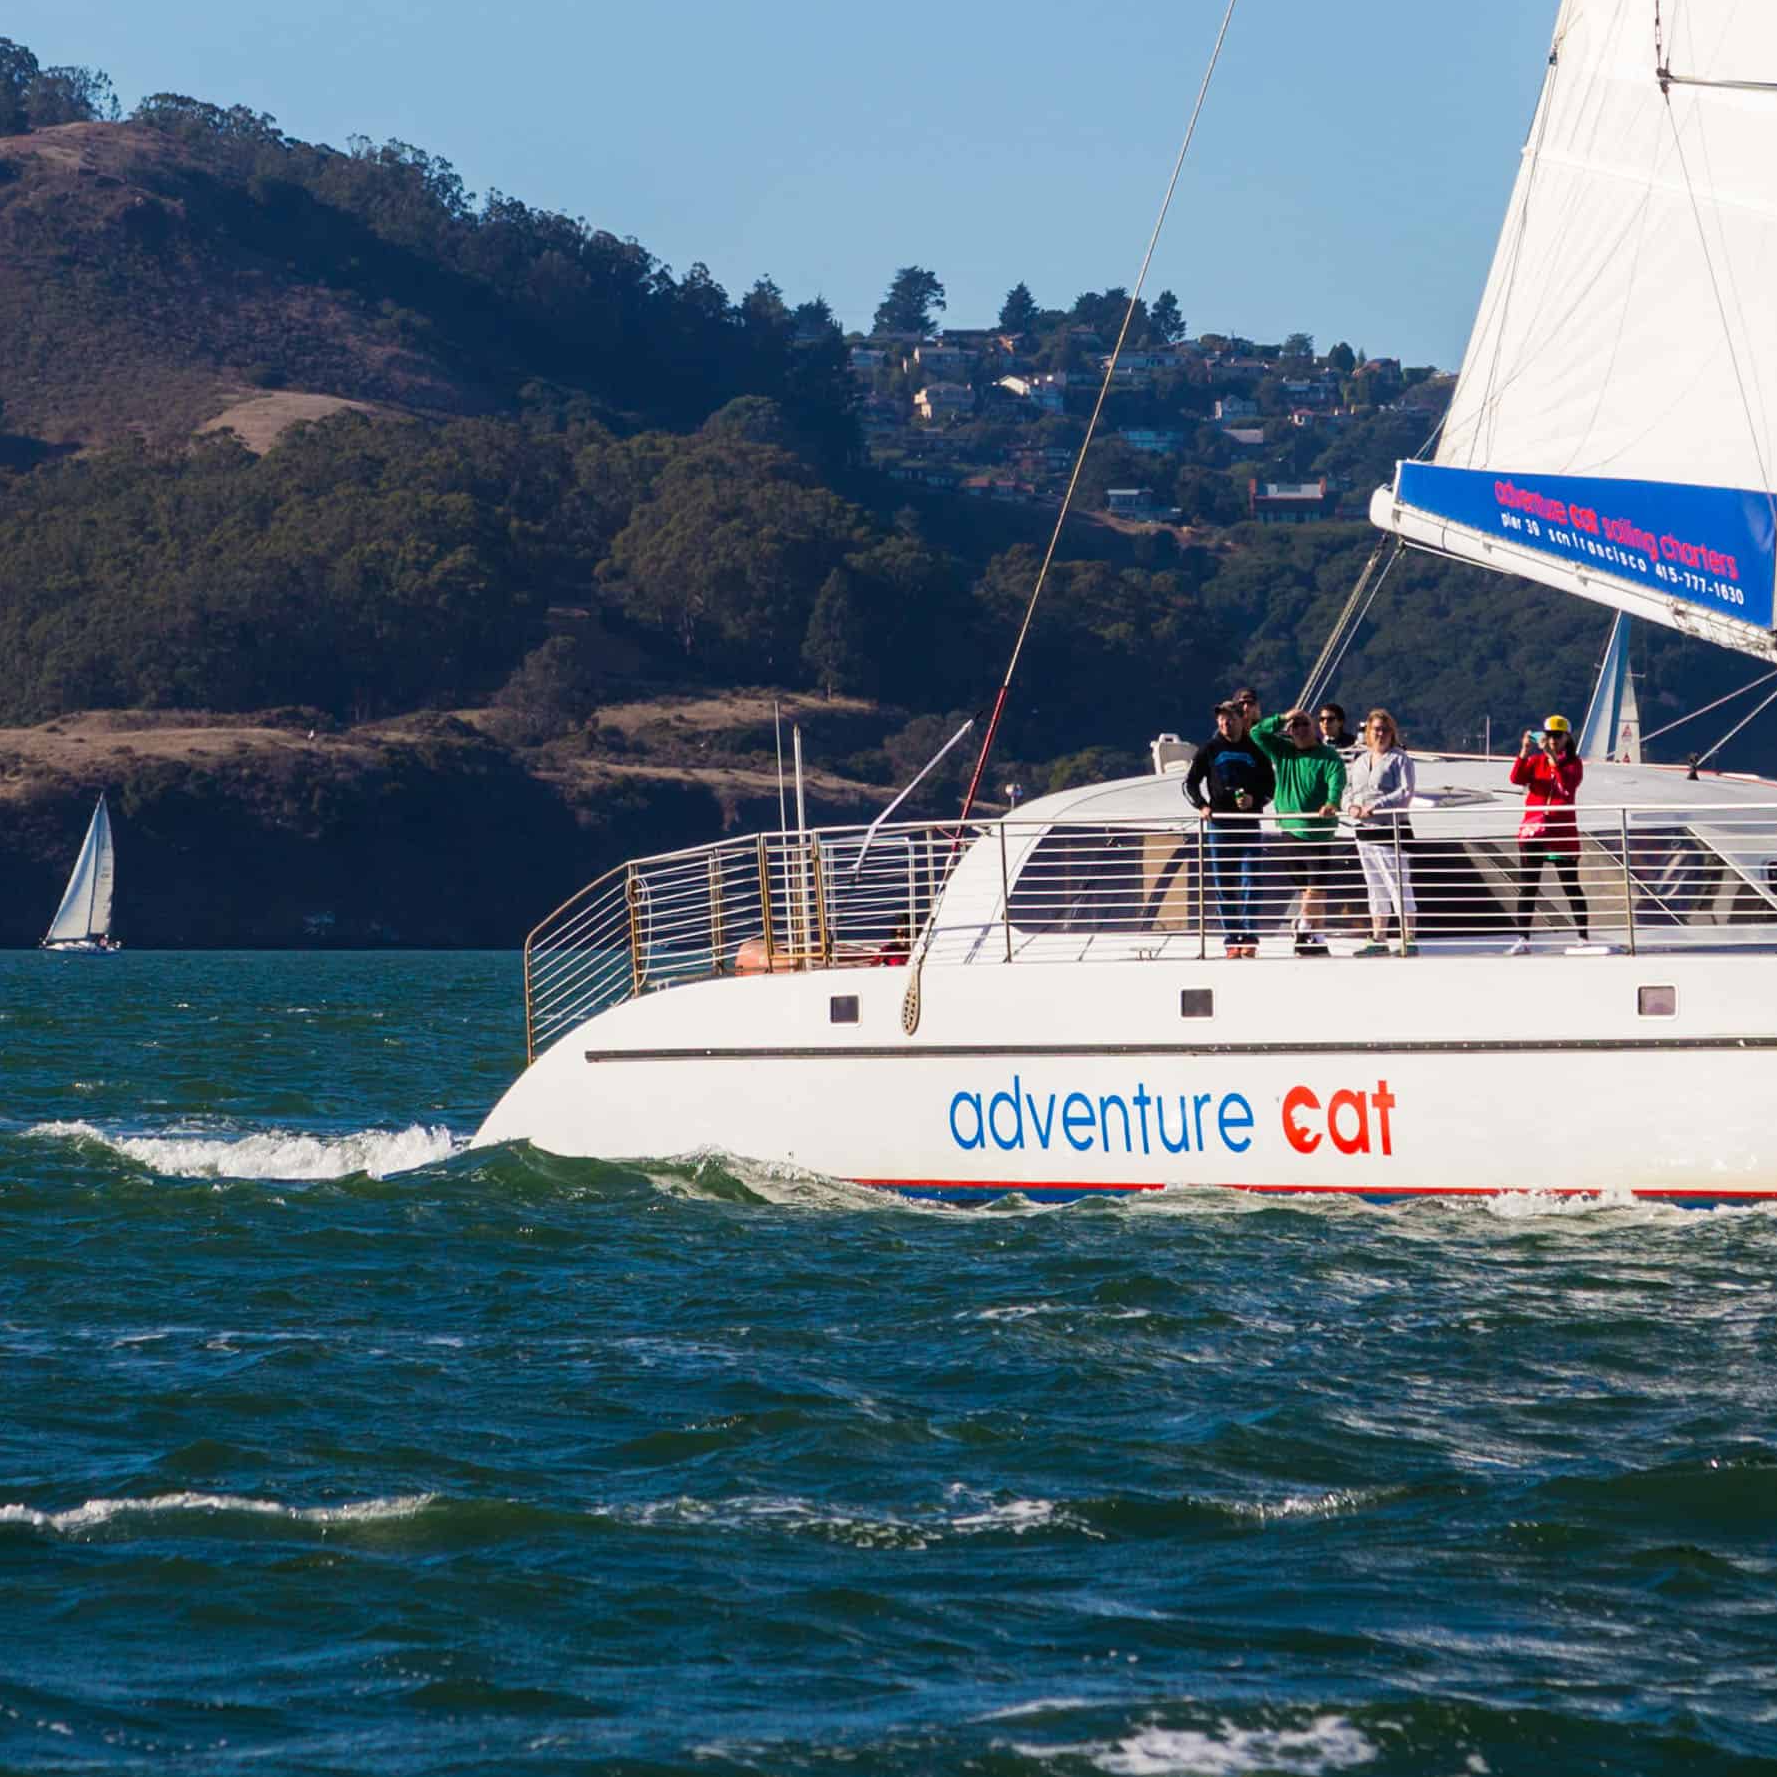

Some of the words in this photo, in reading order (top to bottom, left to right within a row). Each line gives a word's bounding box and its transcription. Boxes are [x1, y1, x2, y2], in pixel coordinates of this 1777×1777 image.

[1494, 479, 1567, 525] adventure
[1569, 504, 1599, 535] cat
[1601, 517, 1660, 562] sailing
[1660, 532, 1739, 580] charters
[1501, 511, 1522, 530] pier
[1548, 528, 1571, 548] san
[1572, 531, 1648, 572] francisco
[949, 1075, 1255, 1155] adventure
[1282, 1079, 1397, 1156] cat
